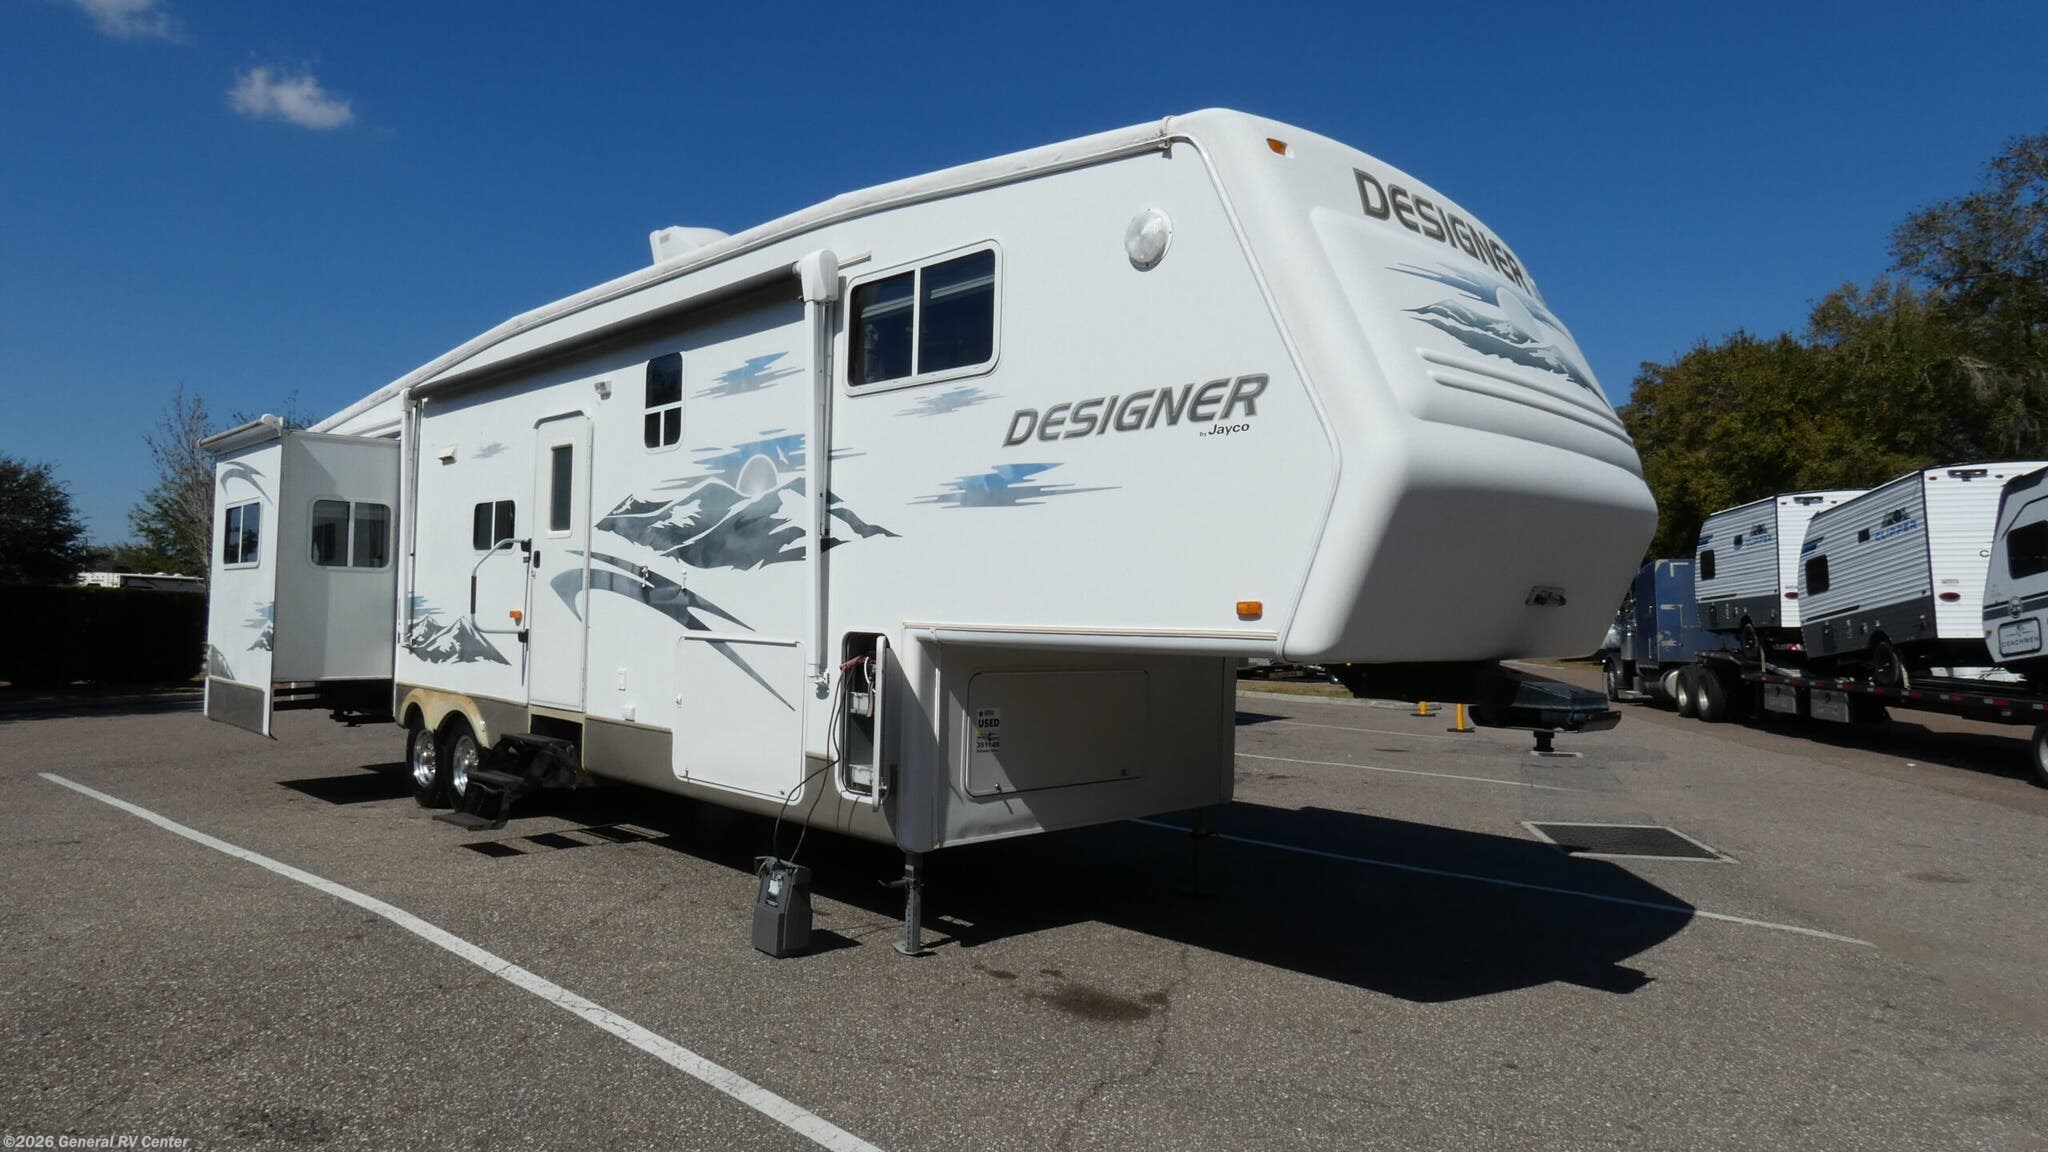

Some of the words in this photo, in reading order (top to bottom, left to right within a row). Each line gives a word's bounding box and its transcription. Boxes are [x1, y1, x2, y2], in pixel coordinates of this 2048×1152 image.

[1352, 167, 1533, 295] DESIGNER
[1002, 373, 1270, 448] DESIGNER
[1208, 424, 1250, 436] Jayco
[1875, 519, 1917, 541] CLIPPER
[2001, 636, 2039, 648] COACHMEN
[978, 719, 1000, 728] USED
